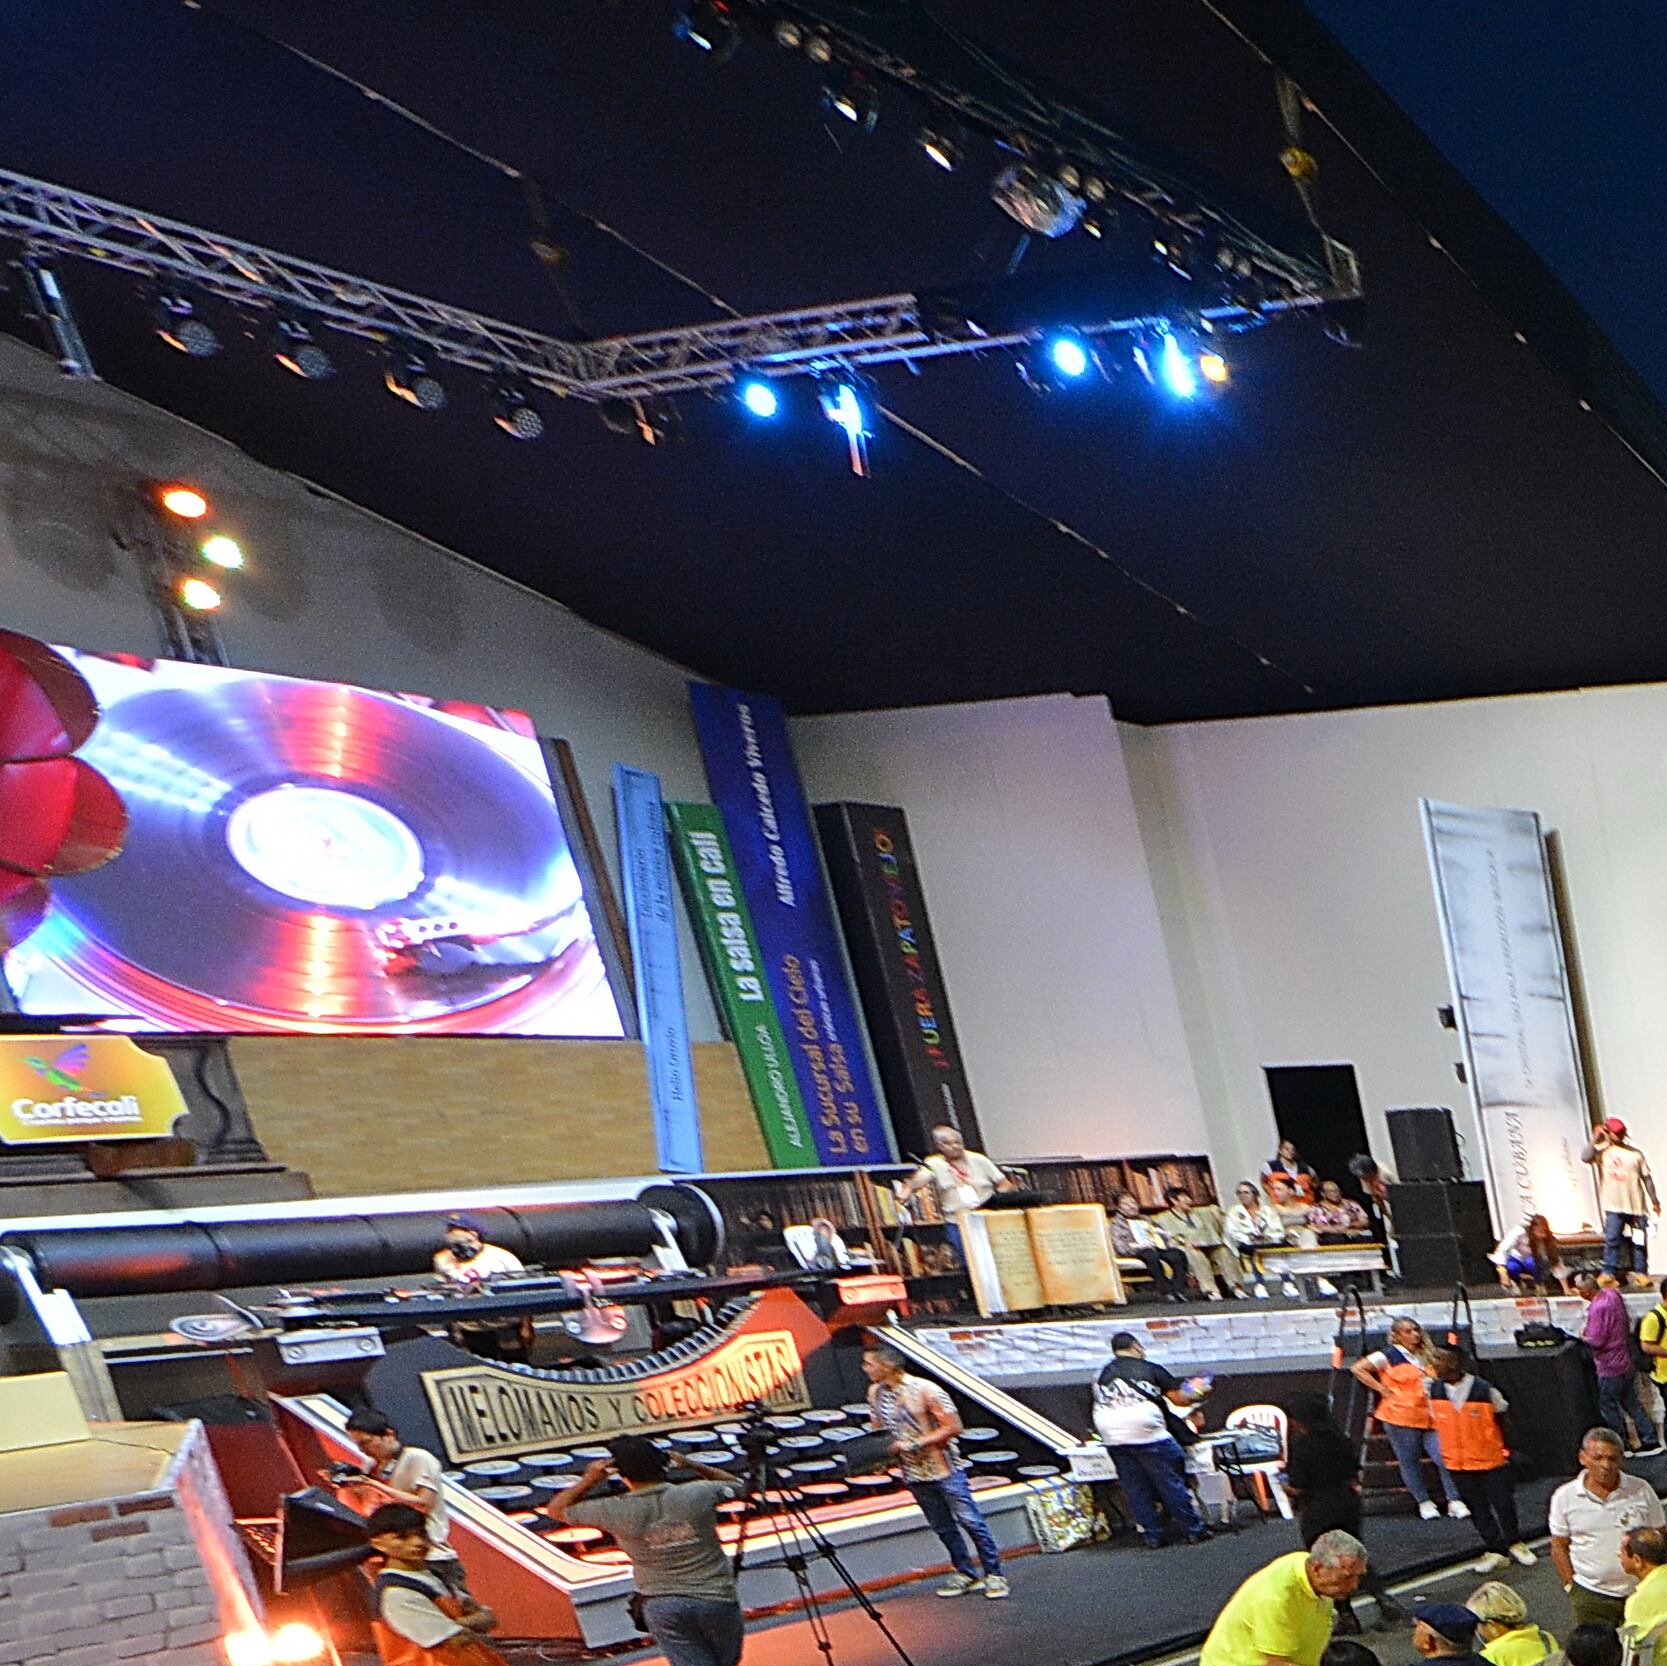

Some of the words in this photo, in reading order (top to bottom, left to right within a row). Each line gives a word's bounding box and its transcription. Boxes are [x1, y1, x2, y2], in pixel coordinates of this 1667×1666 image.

[736, 703, 763, 767] Viveros
[706, 878, 737, 908] en
[769, 844, 796, 907] Alfredo
[716, 912, 756, 972] salsa
[889, 900, 925, 982] ZAPATO
[735, 975, 765, 1001] La
[782, 953, 809, 1005] Cielo
[755, 1024, 780, 1068] ULLOA
[792, 1008, 819, 1040] del
[801, 1044, 841, 1127] Sucursal
[828, 1043, 855, 1092] Salsa
[12, 1095, 140, 1119] Corfecali
[768, 1069, 803, 1148] ALEJANDRO
[844, 1101, 863, 1125] su
[828, 1130, 848, 1154] La
[850, 1129, 869, 1153] en
[450, 1384, 601, 1449] MELOMANOS
[608, 1396, 626, 1426] Y
[634, 1346, 797, 1423] COLECCIONISTAS
